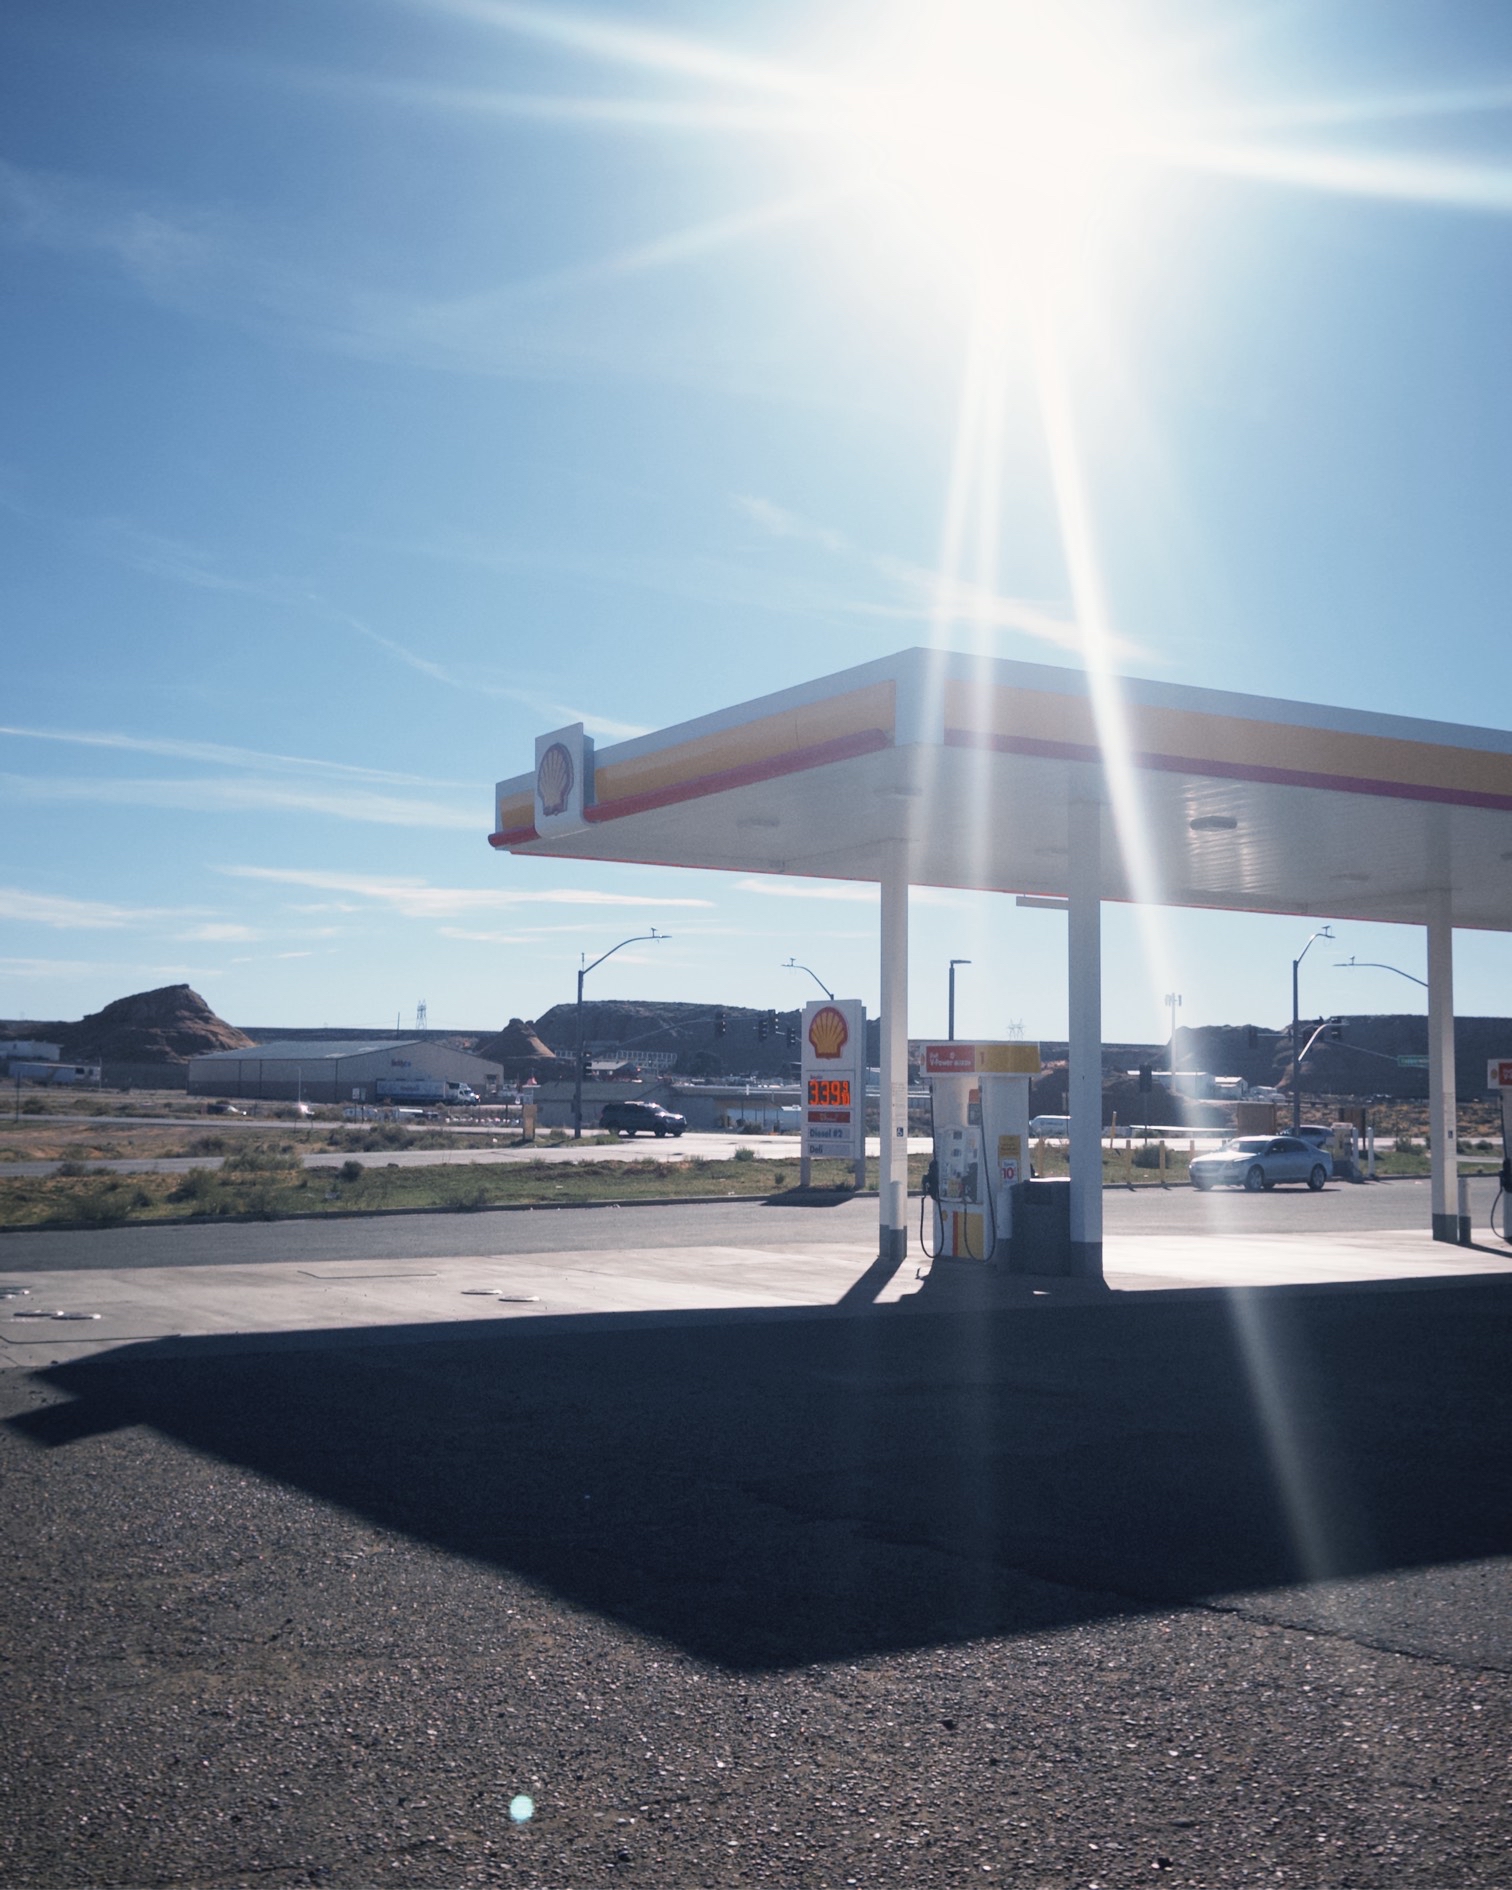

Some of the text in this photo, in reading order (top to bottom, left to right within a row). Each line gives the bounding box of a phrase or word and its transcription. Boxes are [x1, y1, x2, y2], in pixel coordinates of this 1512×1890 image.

[809, 1128, 843, 1138] Diesel #2
[809, 1145, 822, 1153] Deli
